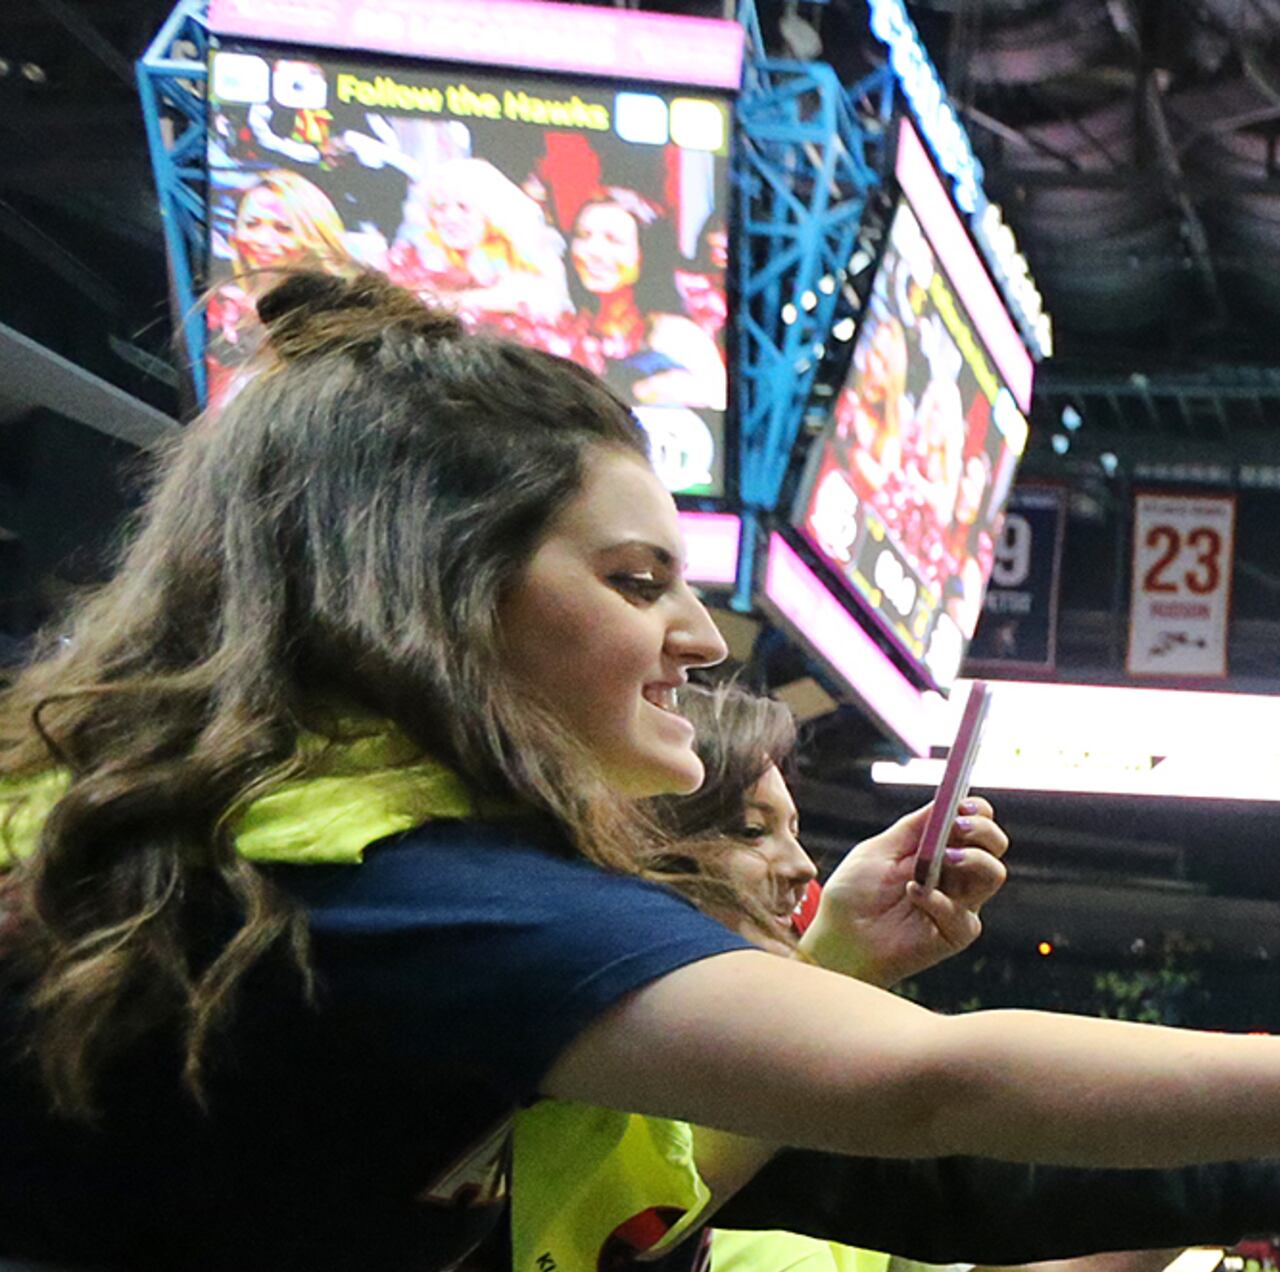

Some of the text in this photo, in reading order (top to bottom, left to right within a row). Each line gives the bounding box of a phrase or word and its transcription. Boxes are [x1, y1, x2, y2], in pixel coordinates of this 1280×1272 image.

[337, 74, 610, 130] Follow the Hawks
[1143, 525, 1221, 595] 23
